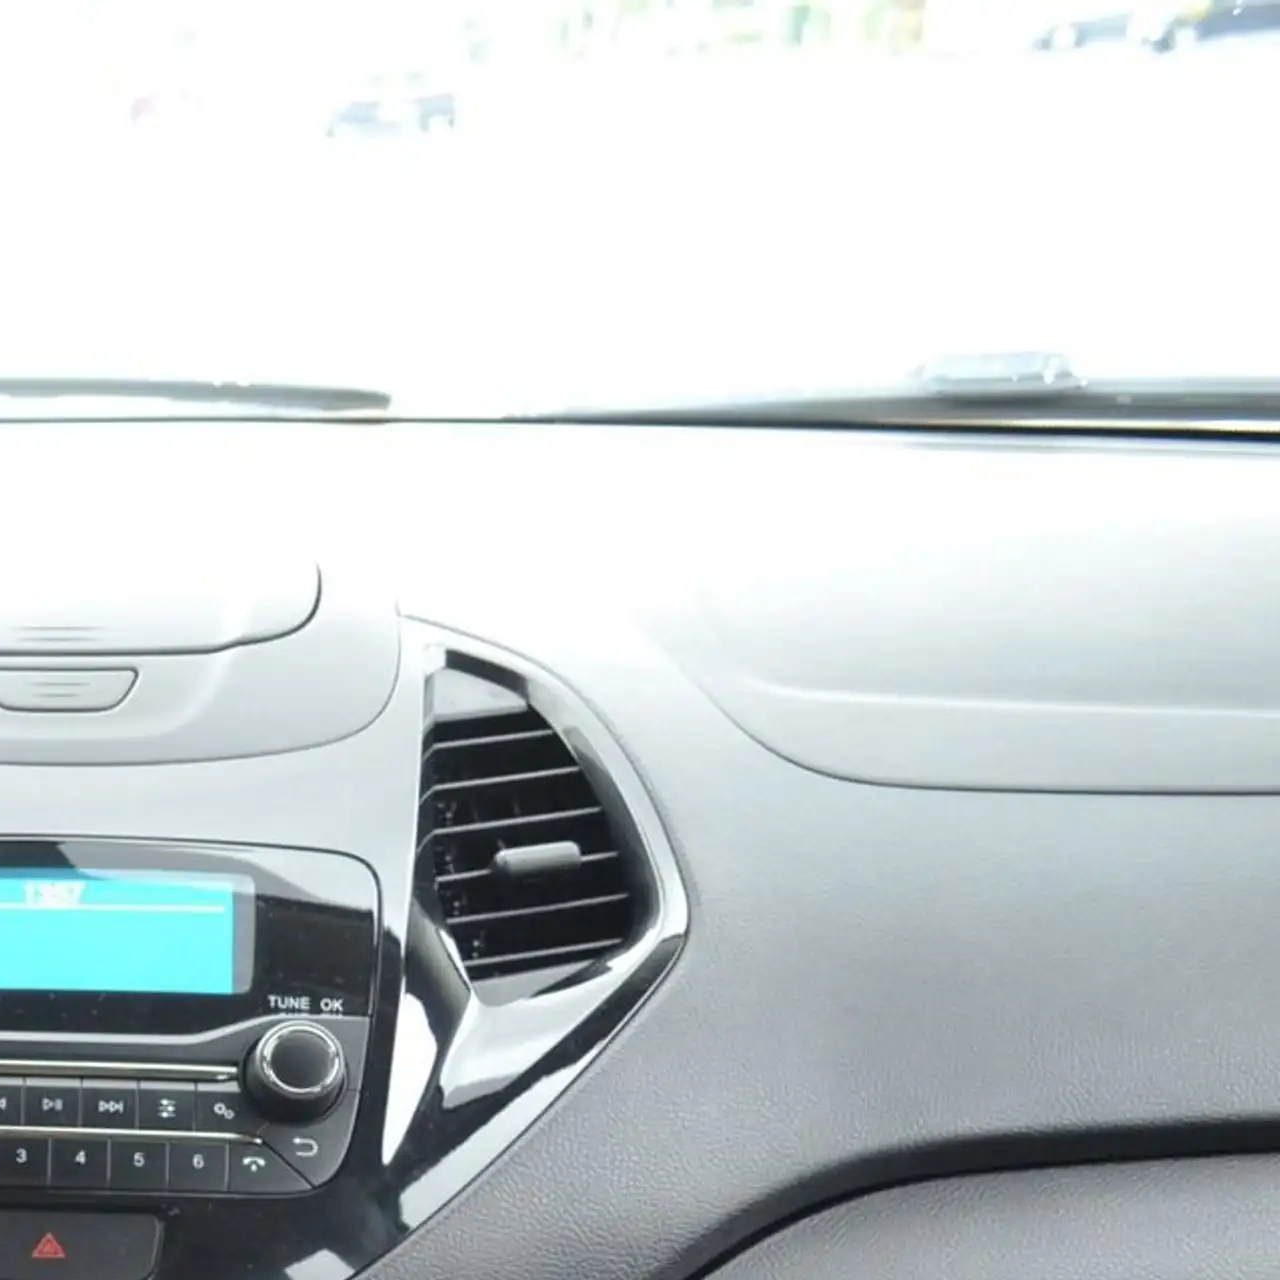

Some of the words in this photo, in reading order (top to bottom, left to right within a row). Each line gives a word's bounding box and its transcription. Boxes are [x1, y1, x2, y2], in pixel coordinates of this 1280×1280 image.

[267, 995, 311, 1010] TUNE
[320, 998, 344, 1012] OK
[15, 1148, 28, 1163] 3
[74, 1150, 86, 1164] 4
[133, 1152, 145, 1167] 5
[192, 1154, 204, 1169] 6
